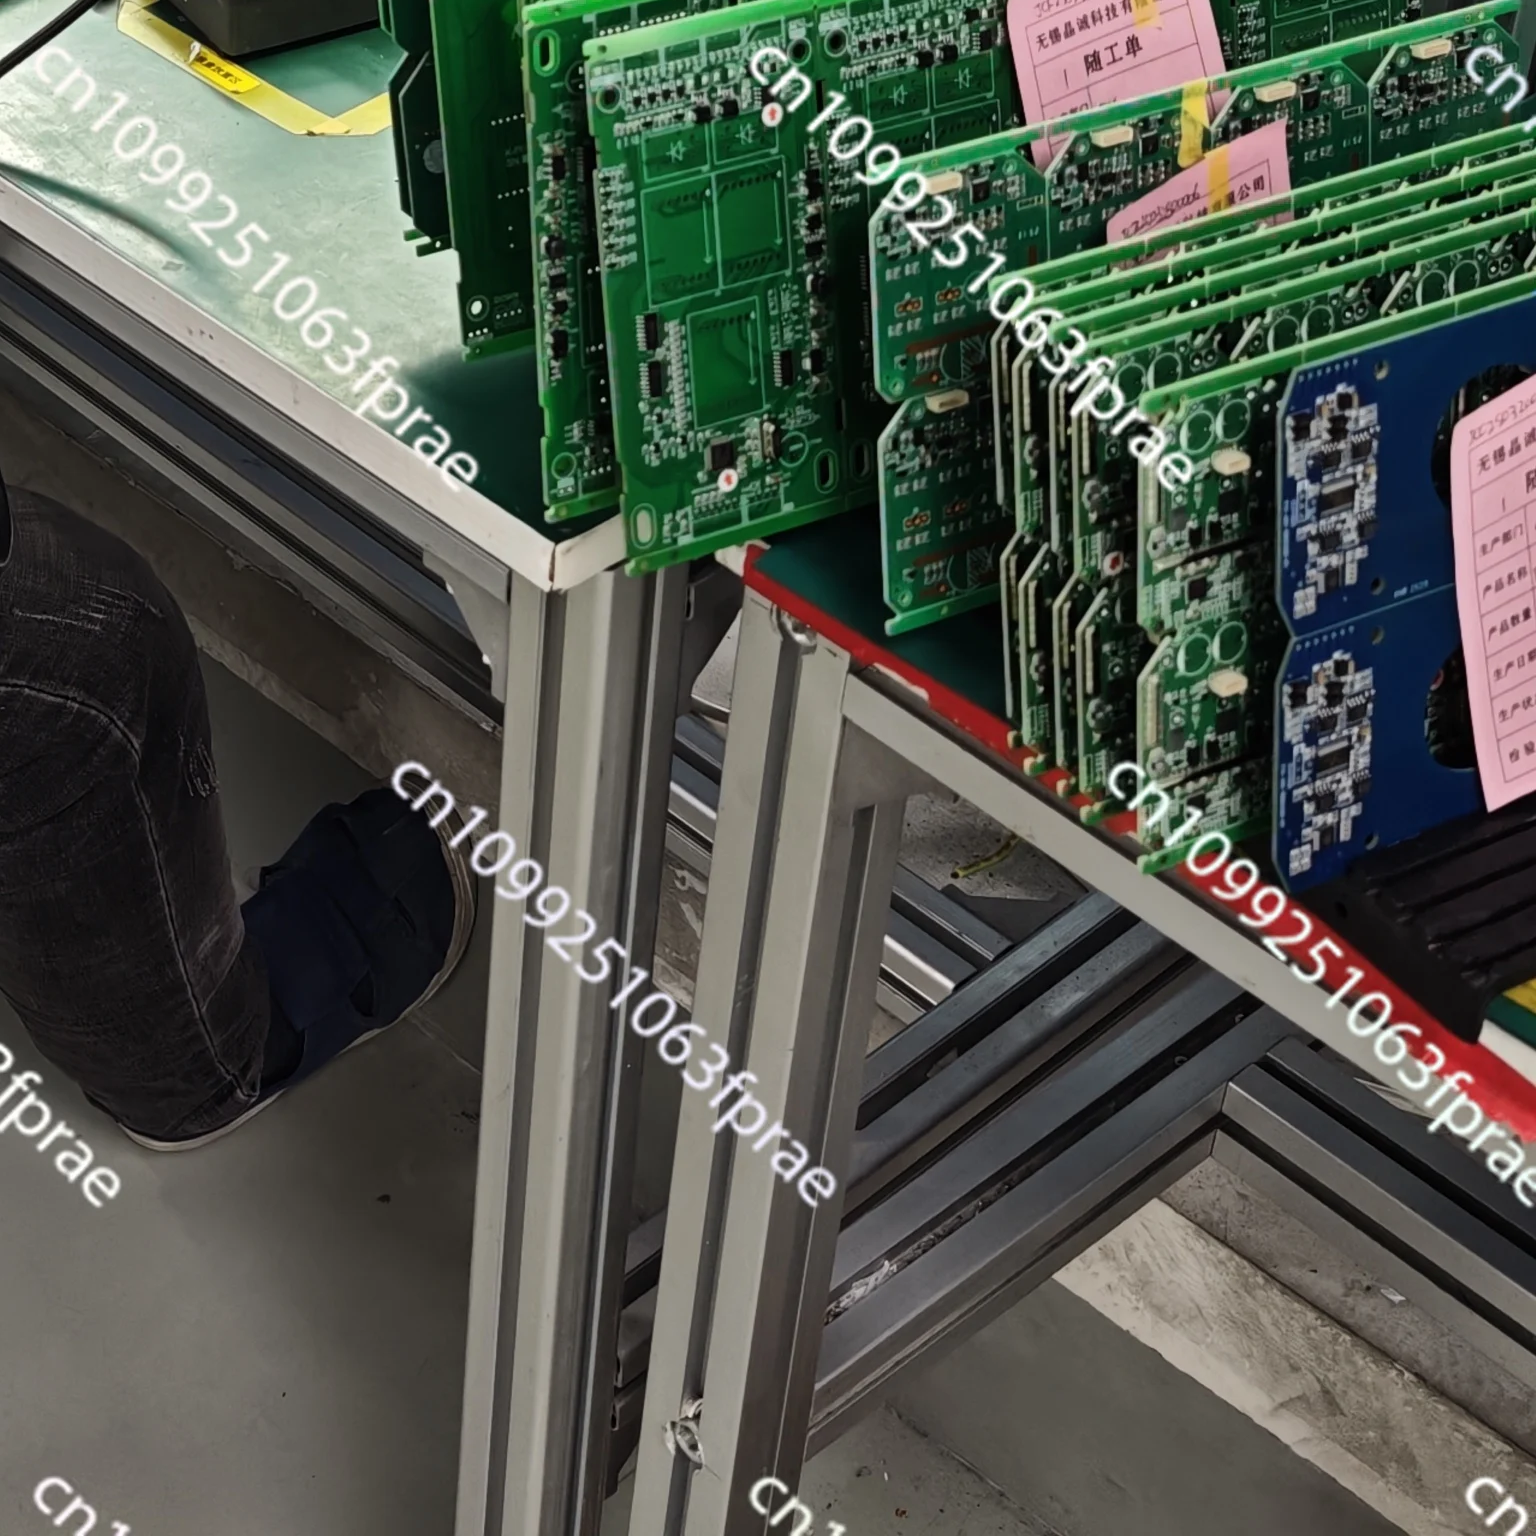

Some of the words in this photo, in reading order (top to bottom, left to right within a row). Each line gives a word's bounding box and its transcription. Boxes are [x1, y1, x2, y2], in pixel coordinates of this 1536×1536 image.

[1082, 34, 1144, 73] 随工单
[1479, 523, 1524, 557] 生产部门
[1482, 565, 1529, 600] 产品名称
[1487, 605, 1533, 642] 产品数量
[1498, 693, 1536, 724] 生产状
